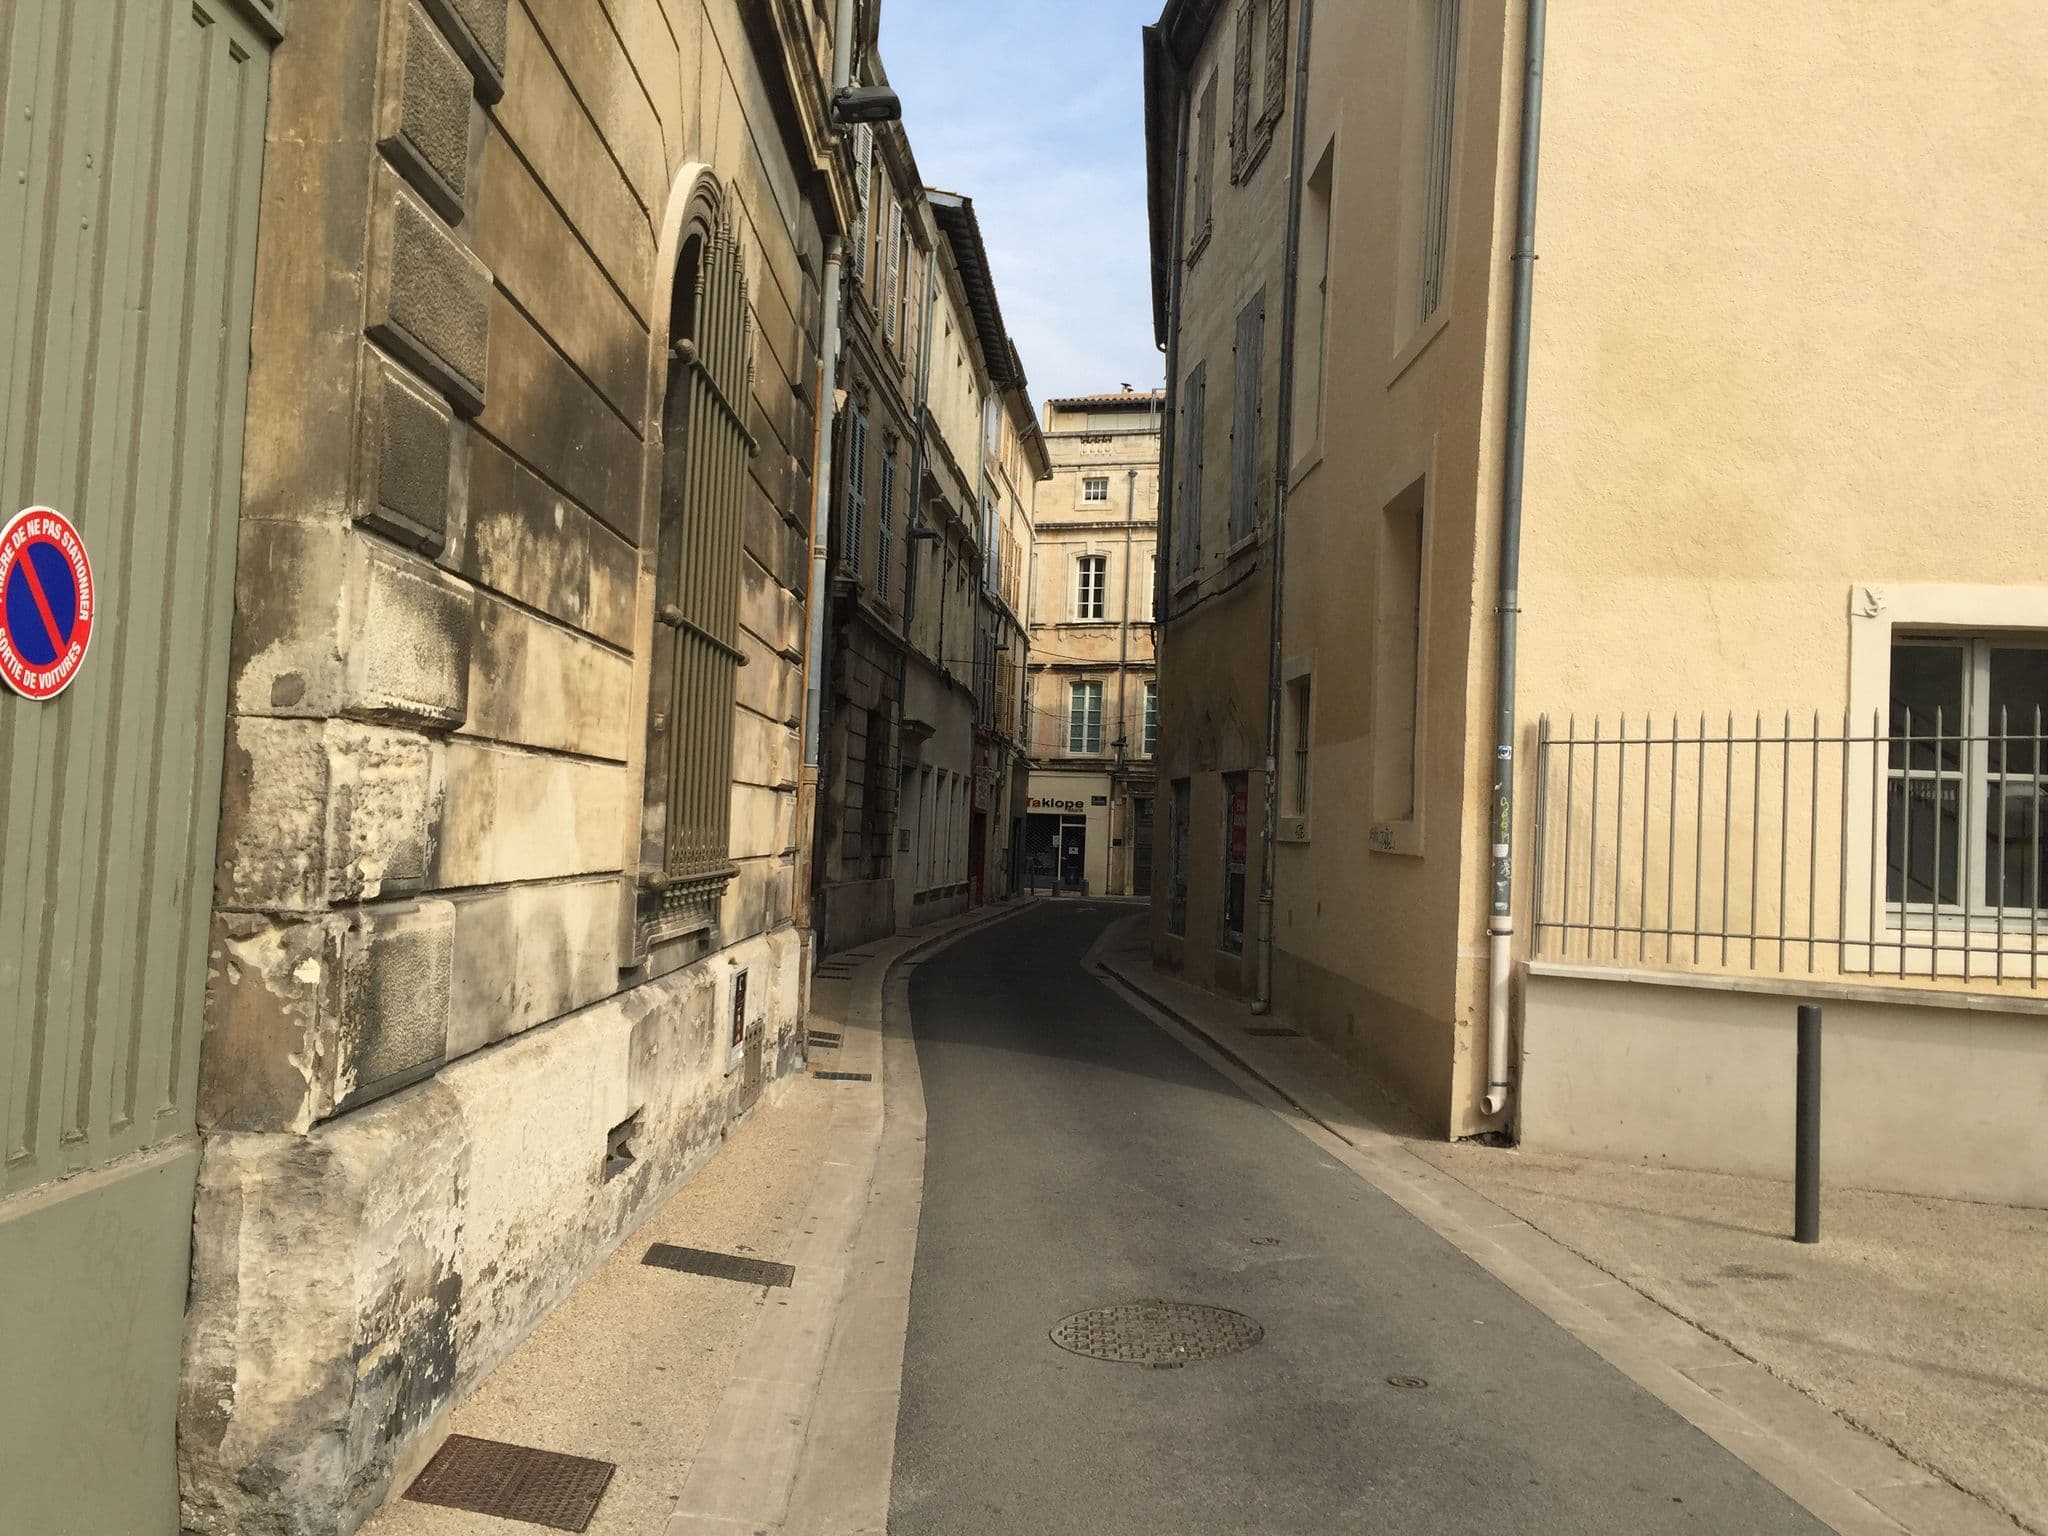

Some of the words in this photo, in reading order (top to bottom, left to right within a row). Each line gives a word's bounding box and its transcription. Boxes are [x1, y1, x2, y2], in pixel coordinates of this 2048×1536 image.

[12, 525, 27, 546] DE
[26, 518, 41, 537] NE
[42, 518, 62, 540] PAS
[61, 531, 90, 621] STATIONNER
[22, 669, 36, 689] DE
[38, 641, 82, 690] VOITURES
[1026, 797, 1084, 809] Taklope
